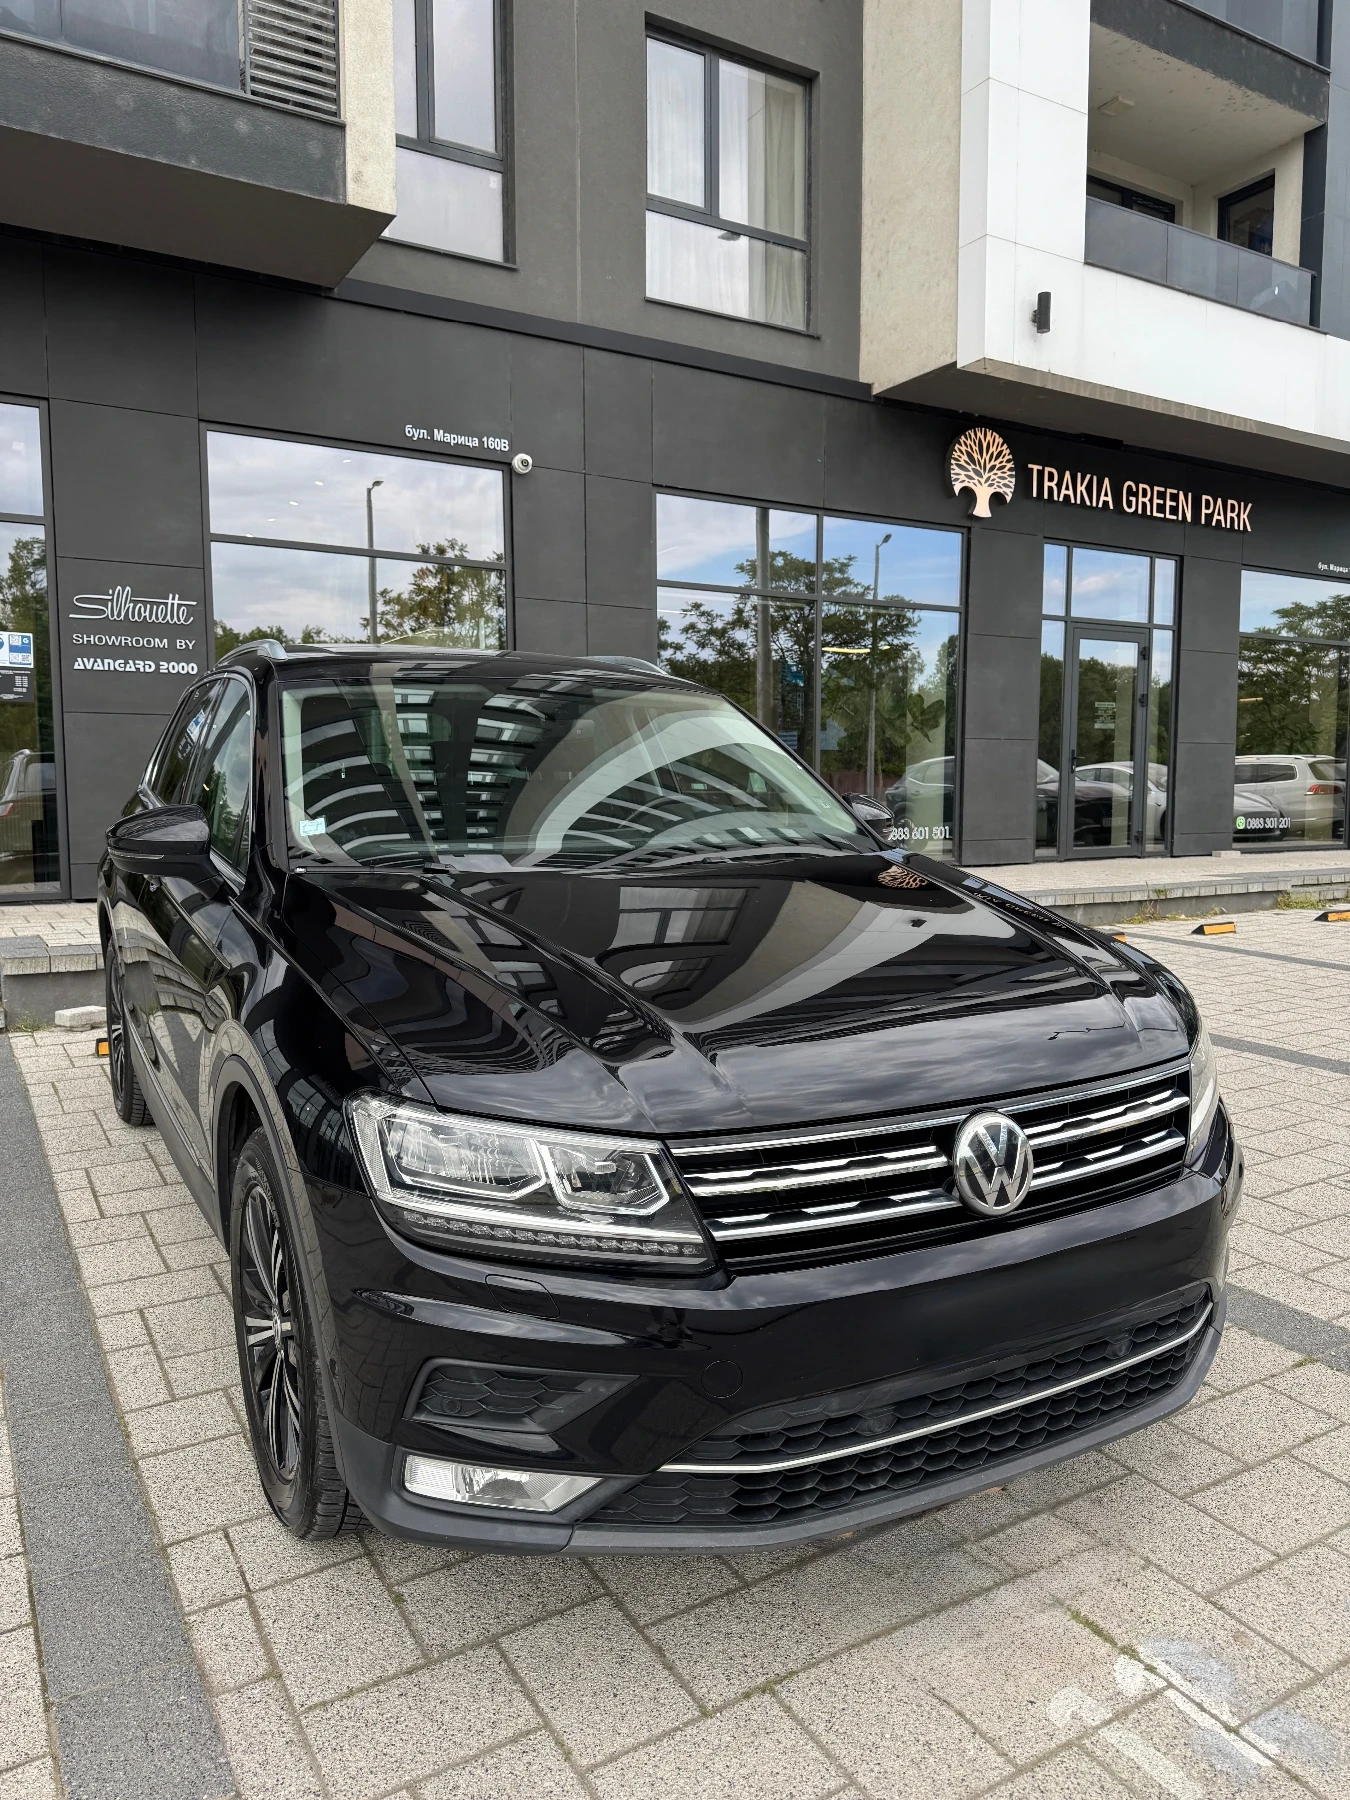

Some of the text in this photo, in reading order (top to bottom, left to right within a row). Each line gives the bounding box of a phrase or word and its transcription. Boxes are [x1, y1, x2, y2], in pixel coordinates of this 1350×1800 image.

[405, 424, 431, 441] бул.
[433, 428, 479, 448] Марица
[1027, 463, 1253, 532] TRAKIA GREEN PARK
[68, 585, 198, 626] Silhouette
[72, 633, 196, 650] SHOWROOM BY
[73, 657, 198, 675] AVANGARD 2000
[1246, 817, 1291, 830] 0883 301 201
[887, 825, 950, 841] 883 601 501
